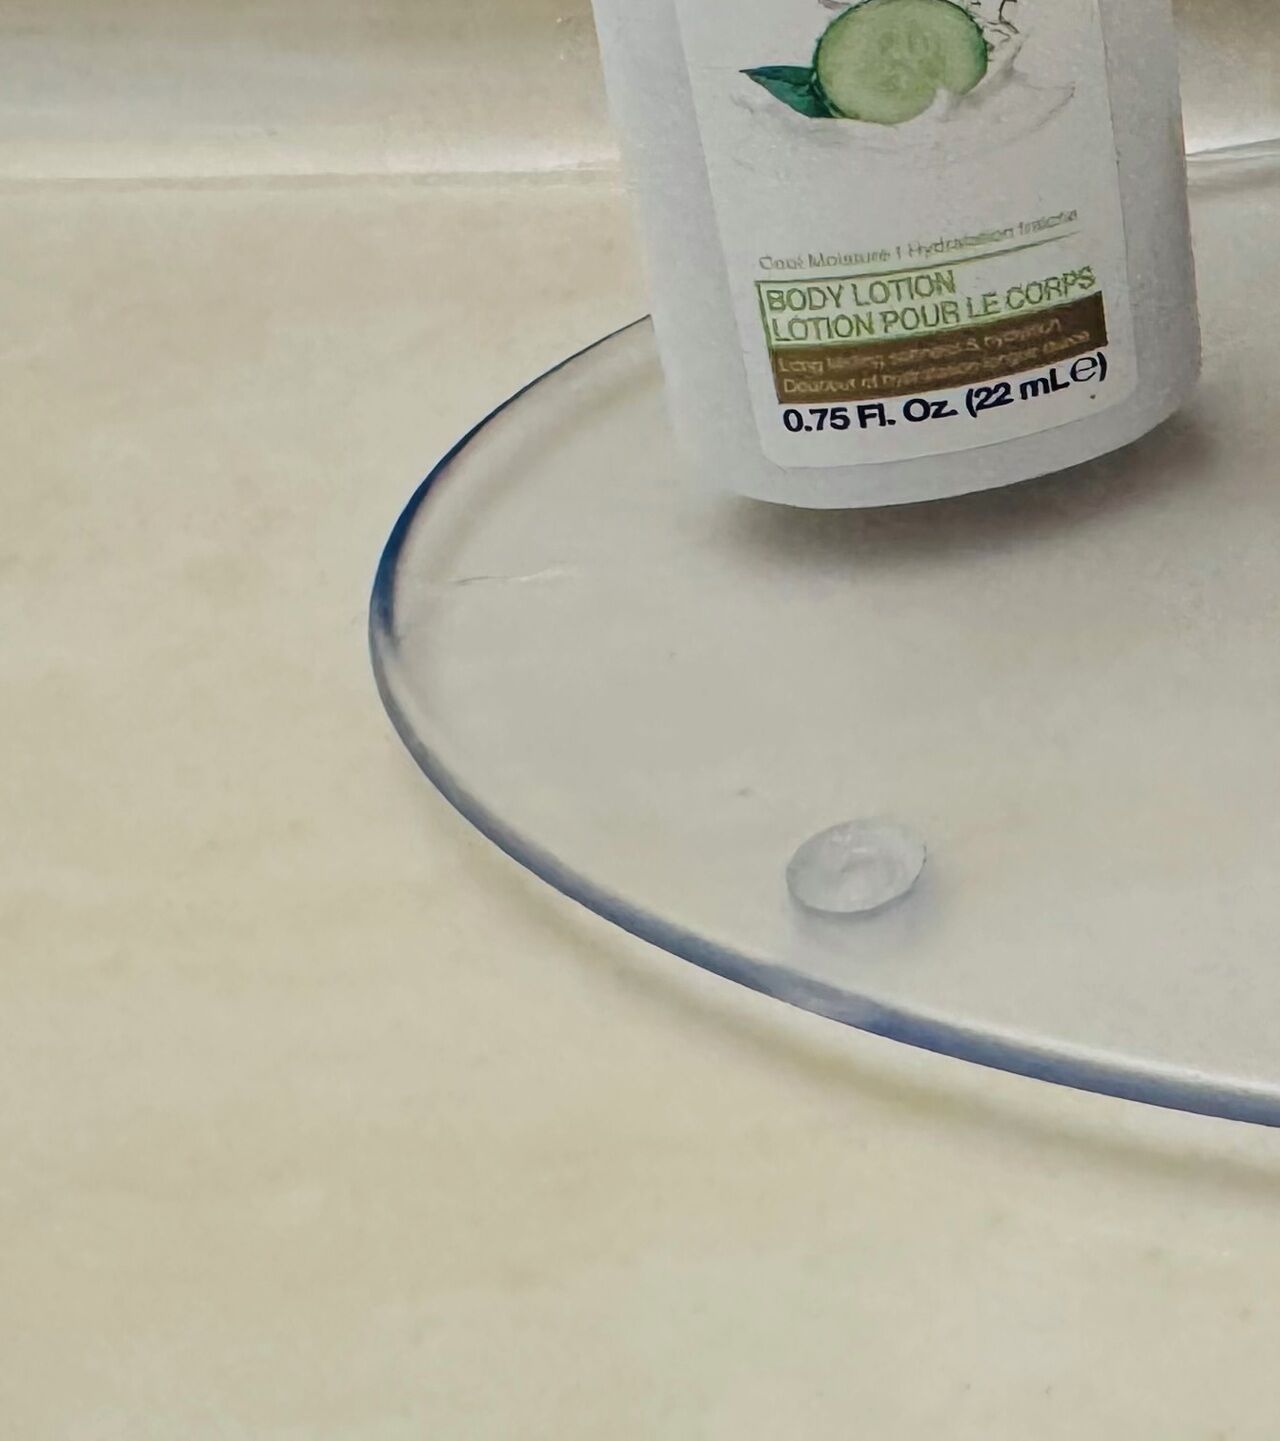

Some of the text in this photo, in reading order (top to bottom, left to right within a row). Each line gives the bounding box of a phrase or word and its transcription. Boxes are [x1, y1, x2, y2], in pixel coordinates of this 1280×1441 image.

[767, 269, 956, 311] BODY LOTION
[772, 265, 1097, 341] LOTION POUR LE CORPS
[782, 406, 850, 433] 0.75
[965, 383, 1014, 418] (22
